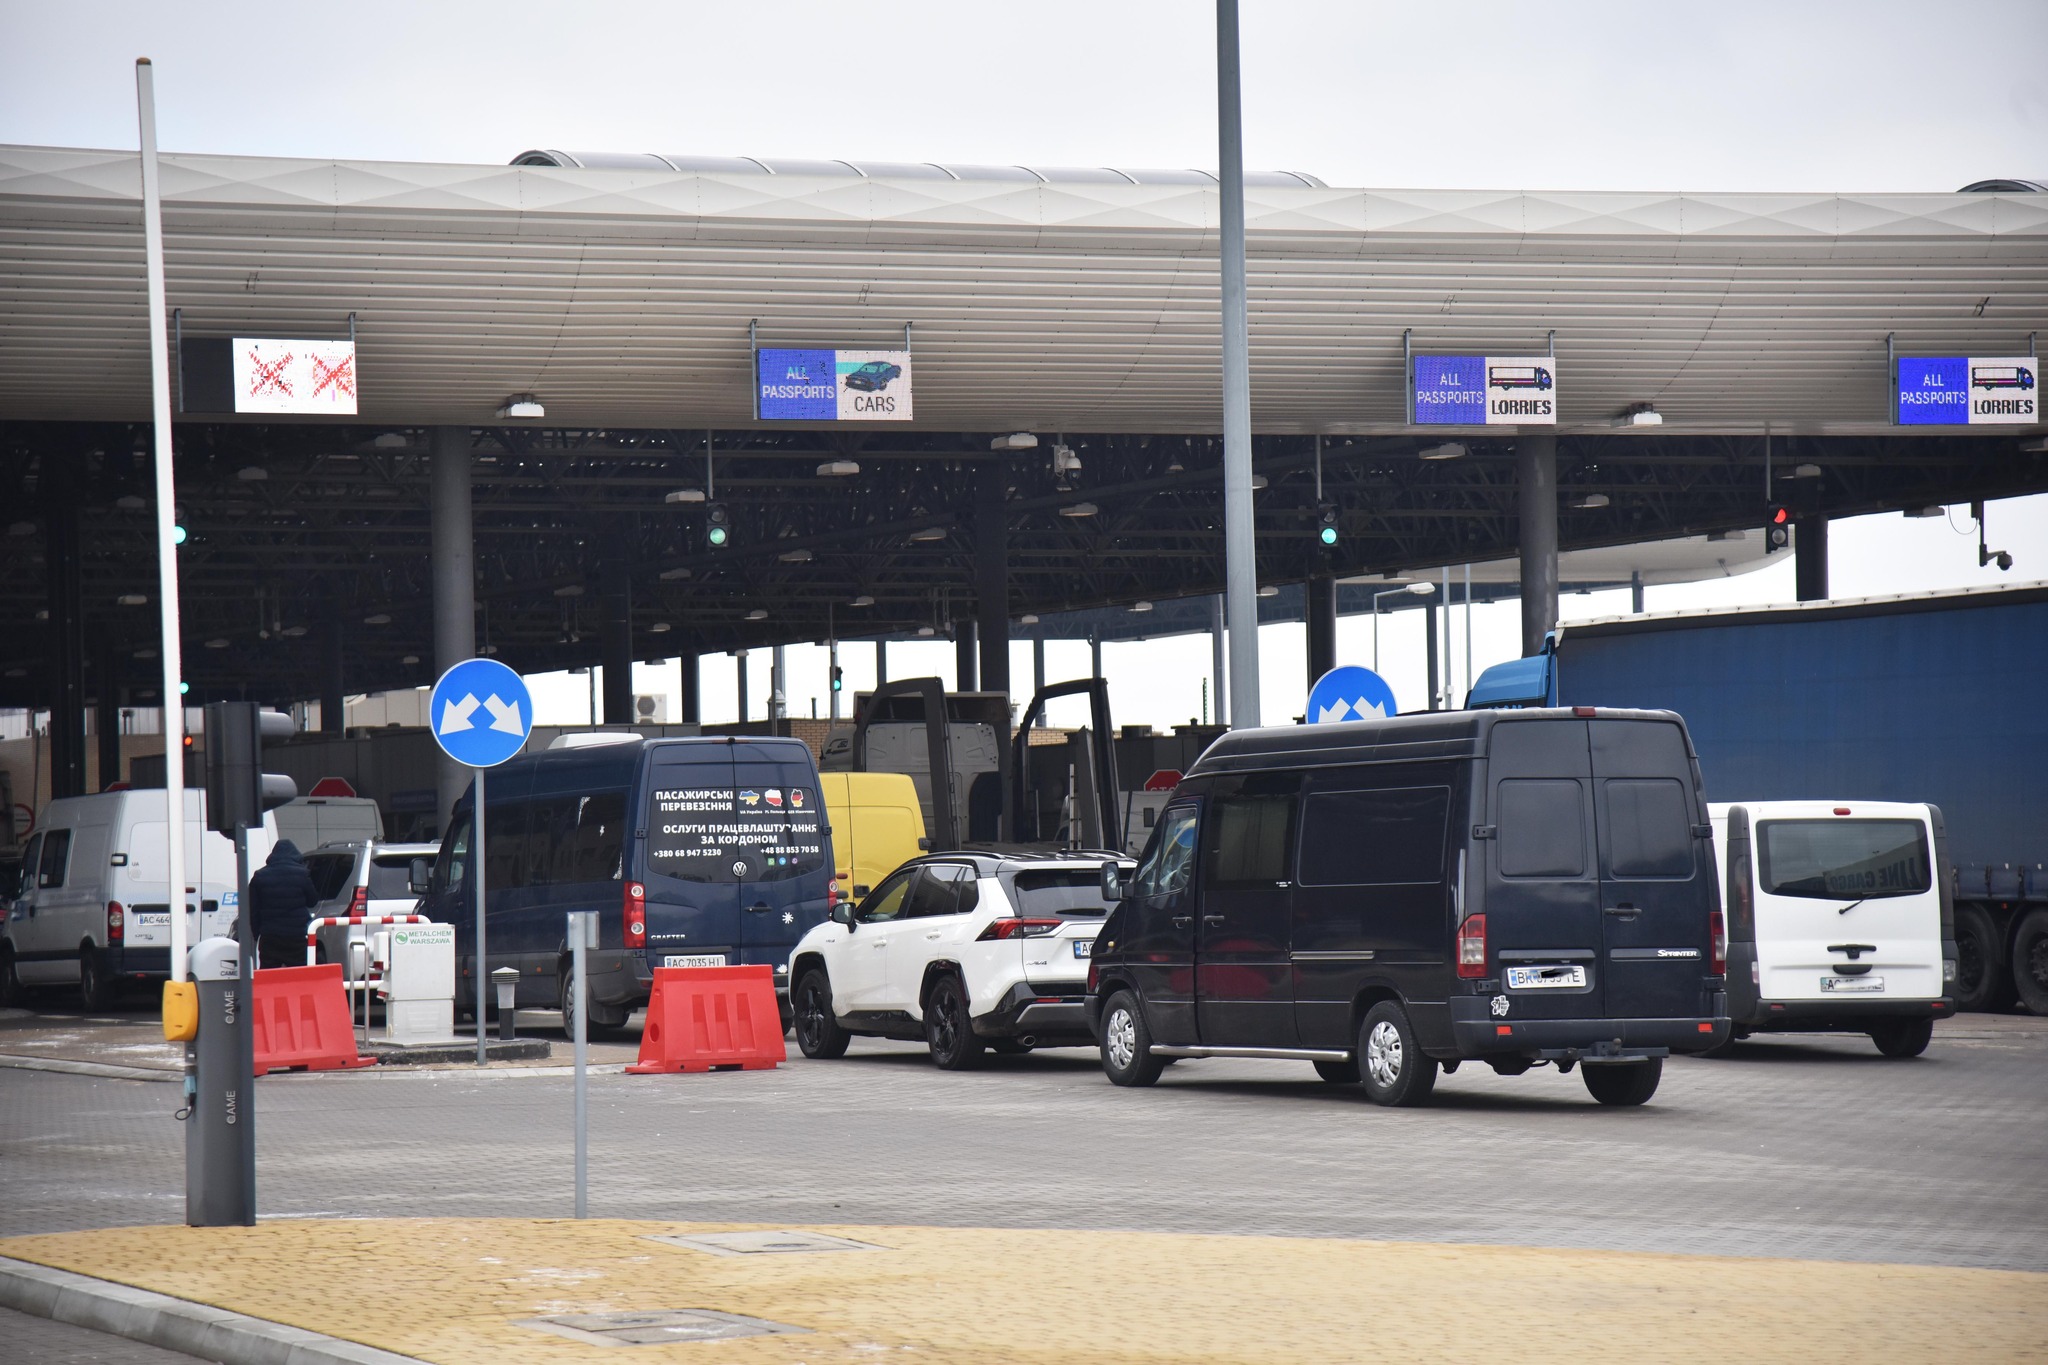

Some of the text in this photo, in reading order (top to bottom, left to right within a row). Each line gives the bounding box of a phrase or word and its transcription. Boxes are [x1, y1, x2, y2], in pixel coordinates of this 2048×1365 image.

[786, 366, 810, 380] ALL
[1439, 373, 1462, 386] ALL
[1923, 374, 1945, 387] ALL
[762, 385, 835, 399] PASSPORTS
[1417, 391, 1484, 404] PASSPORTS
[1901, 391, 1967, 405] PASSPORTS
[854, 396, 895, 412] CARS
[1491, 399, 1552, 415] LORRIES
[1974, 399, 2034, 415] LORRIES
[656, 791, 733, 800] ПАСАЖИРСЬКІ
[708, 824, 817, 835] ПРАЦЕВЛАШТУАННЯ
[701, 835, 778, 846] ЗА КОРДОНОМ
[653, 848, 722, 858] +380 68 947 5230
[760, 846, 774, 854] +48
[775, 846, 785, 854] 88
[786, 846, 800, 854] 853
[143, 915, 155, 924] AC
[672, 958, 685, 967] AC
[687, 958, 707, 967] 7035
[224, 990, 235, 1025] CAME
[226, 1090, 236, 1125] CAME
